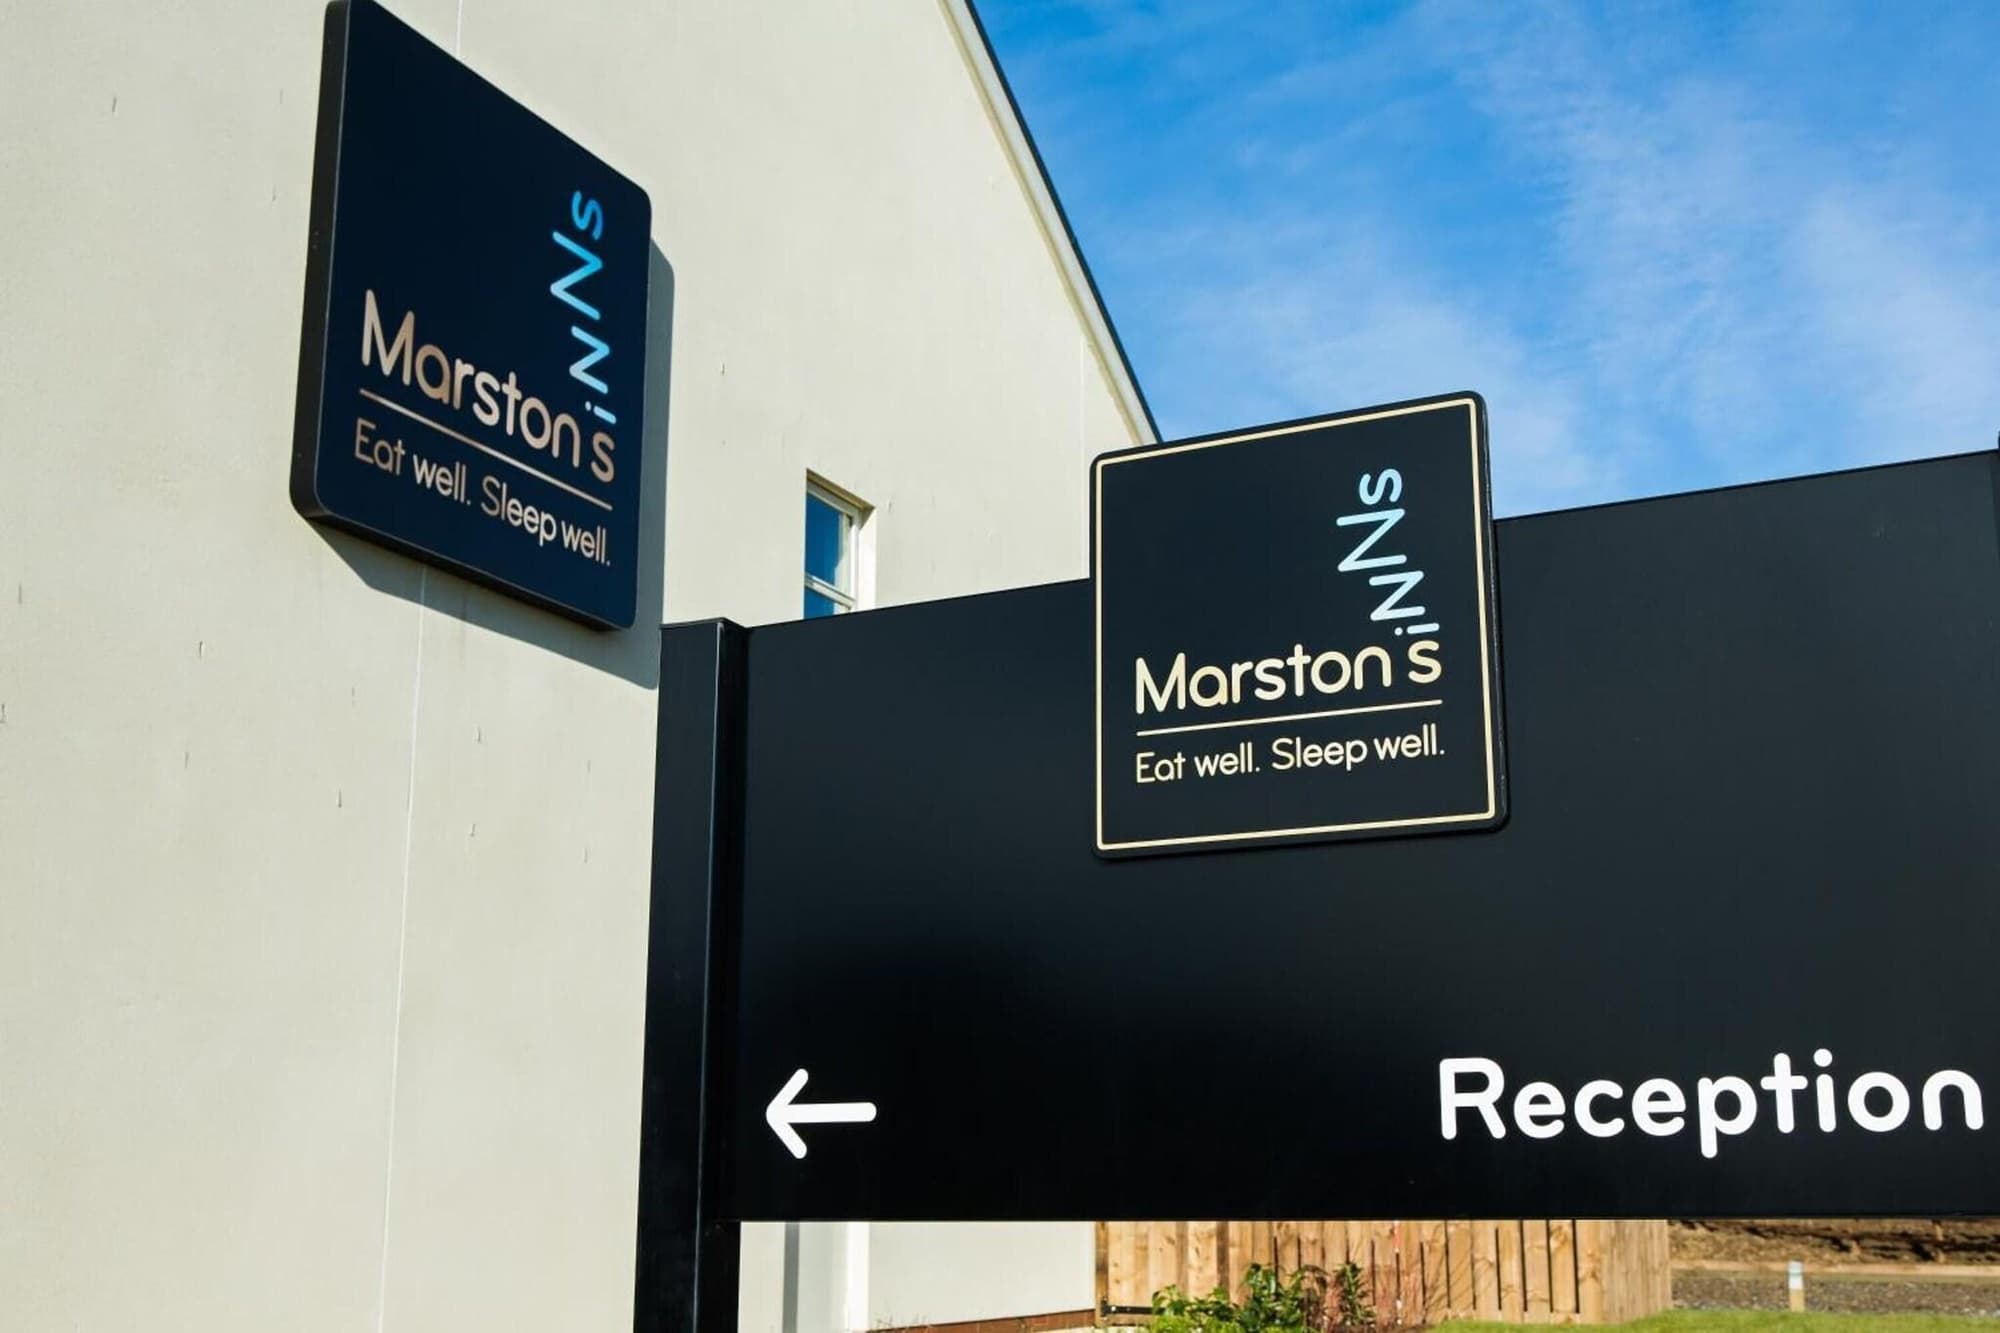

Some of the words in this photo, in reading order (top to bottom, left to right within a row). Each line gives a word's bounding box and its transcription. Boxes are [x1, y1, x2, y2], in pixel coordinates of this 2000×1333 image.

[354, 417, 406, 475] Eat
[412, 452, 472, 505] well.
[481, 474, 557, 546] Sleep
[561, 519, 612, 567] well.
[1136, 751, 1186, 784] Eat
[1194, 741, 1261, 777] well.
[1271, 737, 1368, 771] Sleep
[1374, 723, 1446, 760] well.
[1439, 1048, 1985, 1159] Reception
